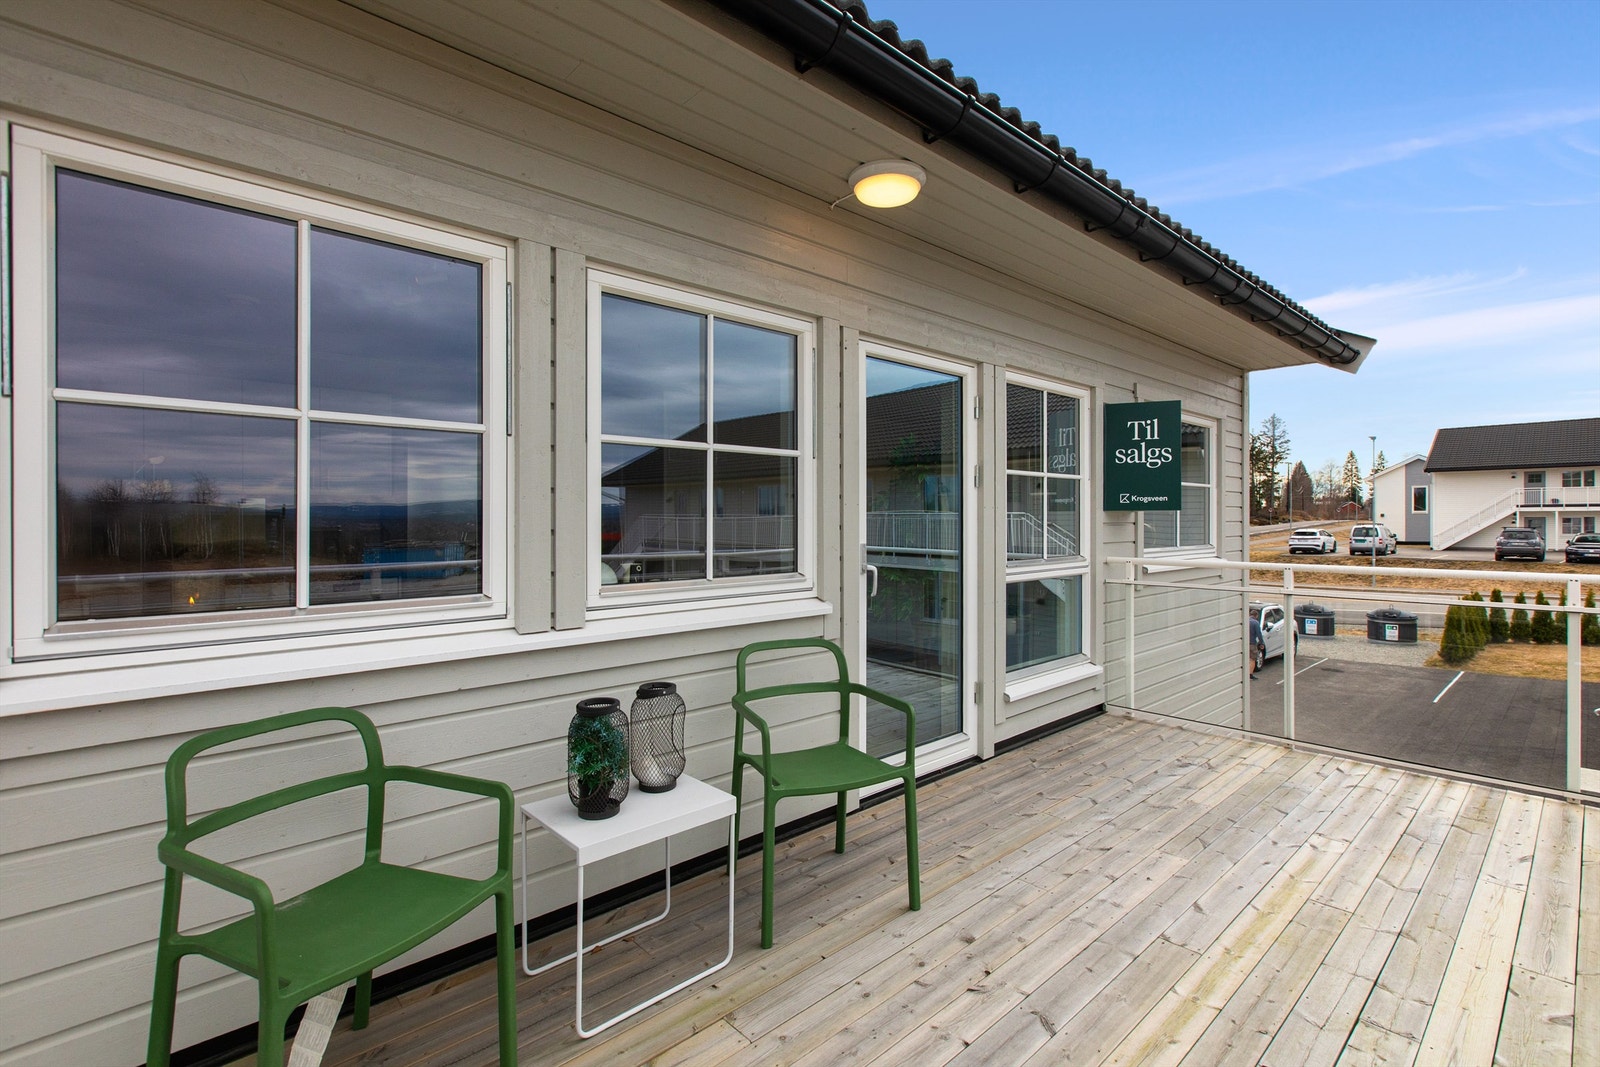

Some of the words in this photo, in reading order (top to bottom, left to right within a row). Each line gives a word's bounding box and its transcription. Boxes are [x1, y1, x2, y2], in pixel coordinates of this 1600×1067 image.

[1127, 418, 1160, 440] Til
[1115, 441, 1173, 468] salgs
[1131, 495, 1168, 503] Krogsveen
